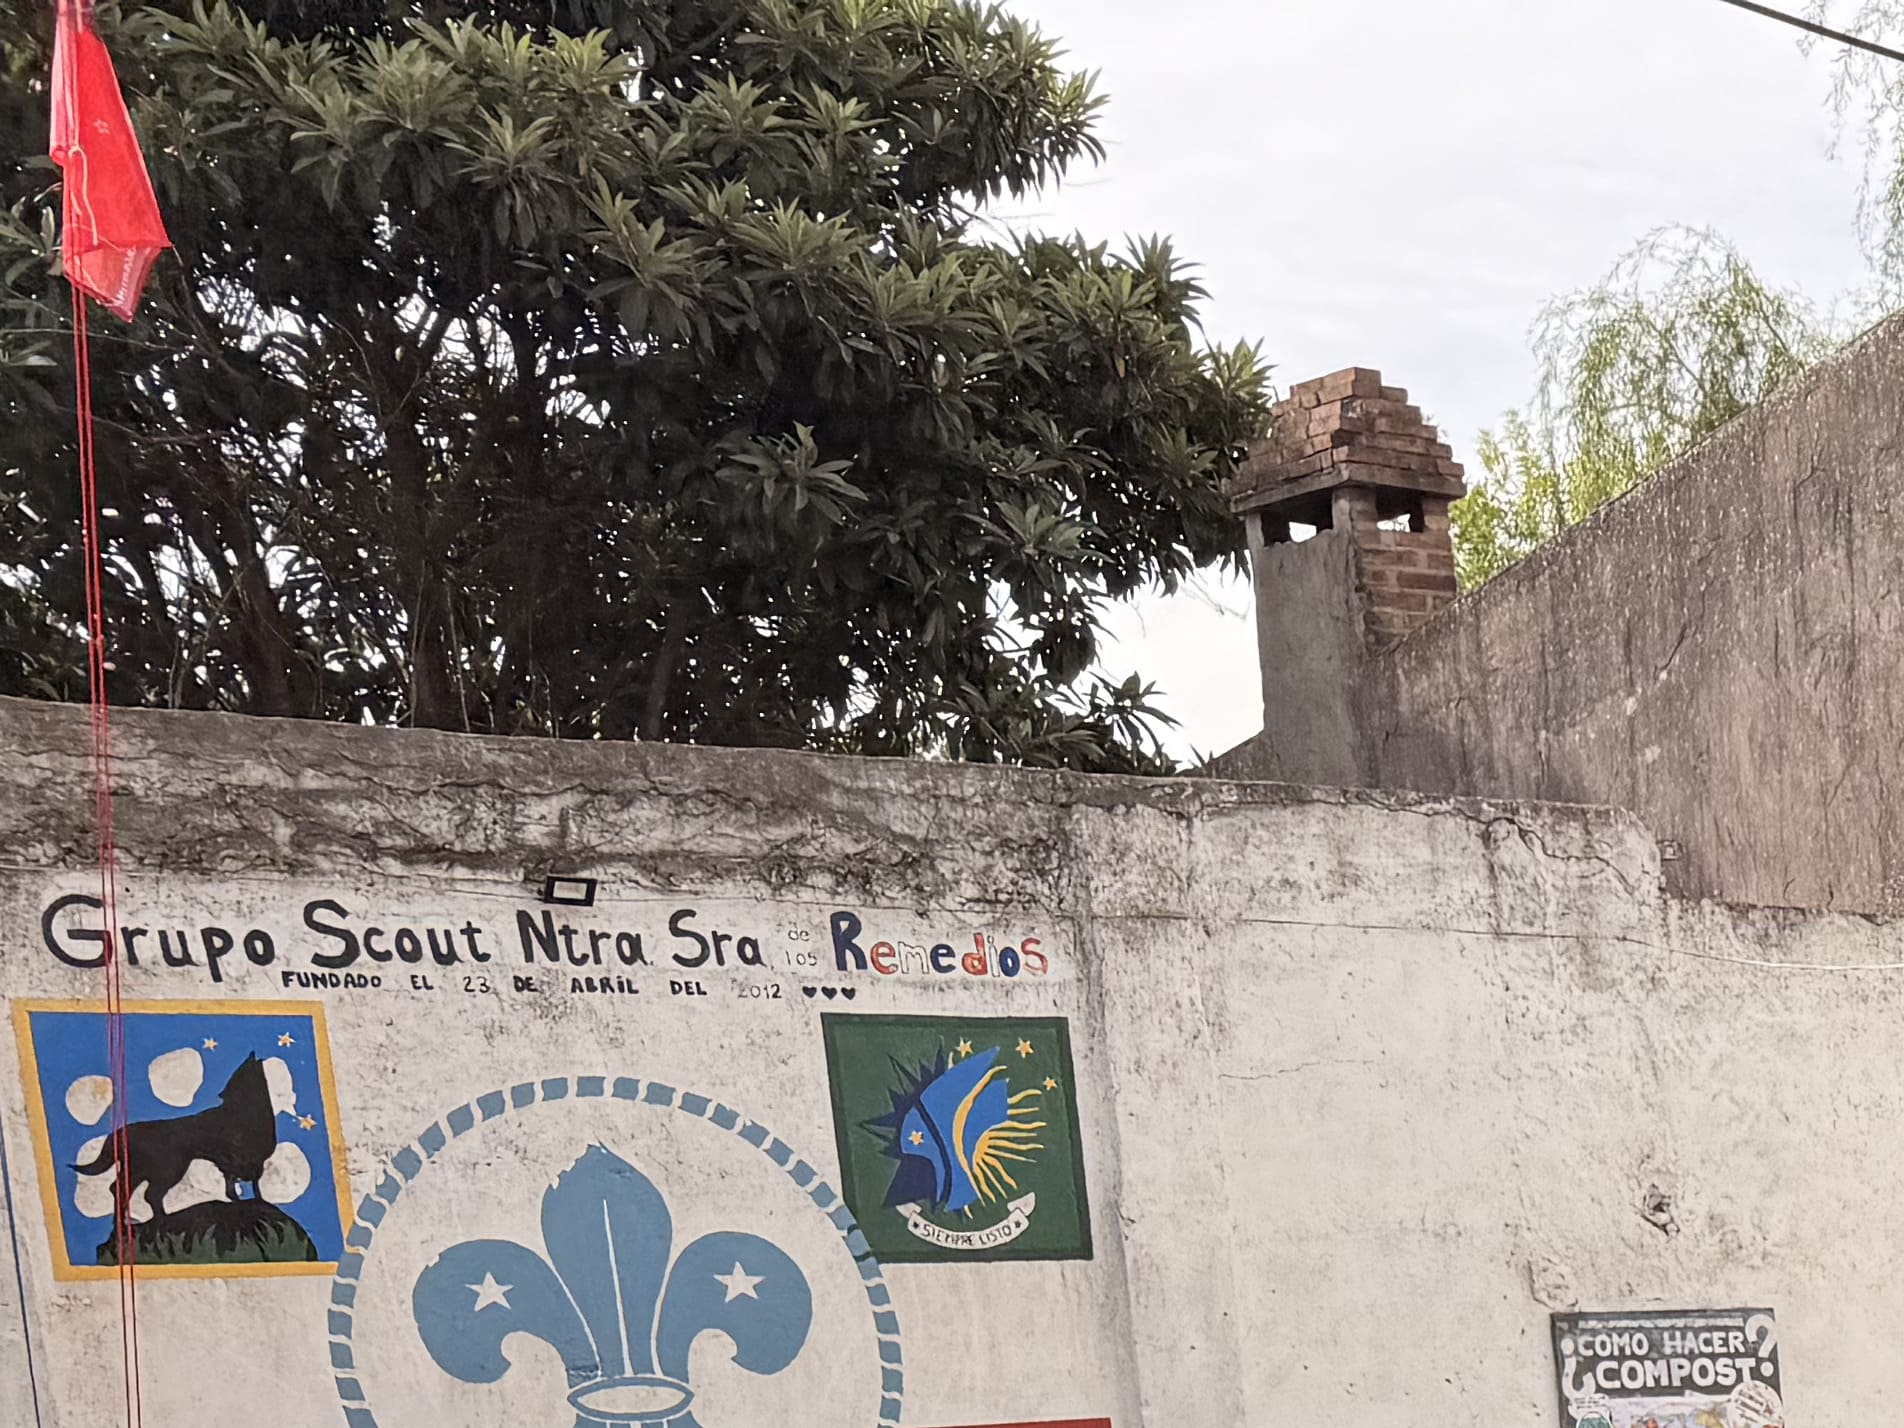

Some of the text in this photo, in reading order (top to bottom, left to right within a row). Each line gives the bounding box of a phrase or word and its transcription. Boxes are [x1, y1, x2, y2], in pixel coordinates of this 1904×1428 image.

[41, 894, 275, 983] Grupo
[302, 898, 492, 969] Scout
[787, 922, 810, 942] de
[830, 911, 1050, 979] Remedios
[281, 970, 382, 989] FUNDADO
[411, 974, 434, 991] EL
[463, 976, 491, 994] 23
[513, 975, 538, 993] DE
[670, 979, 708, 996] DEL
[736, 982, 783, 1000] 2012
[979, 1224, 1013, 1246] LISTO
[1662, 1331, 1745, 1355] HACER
